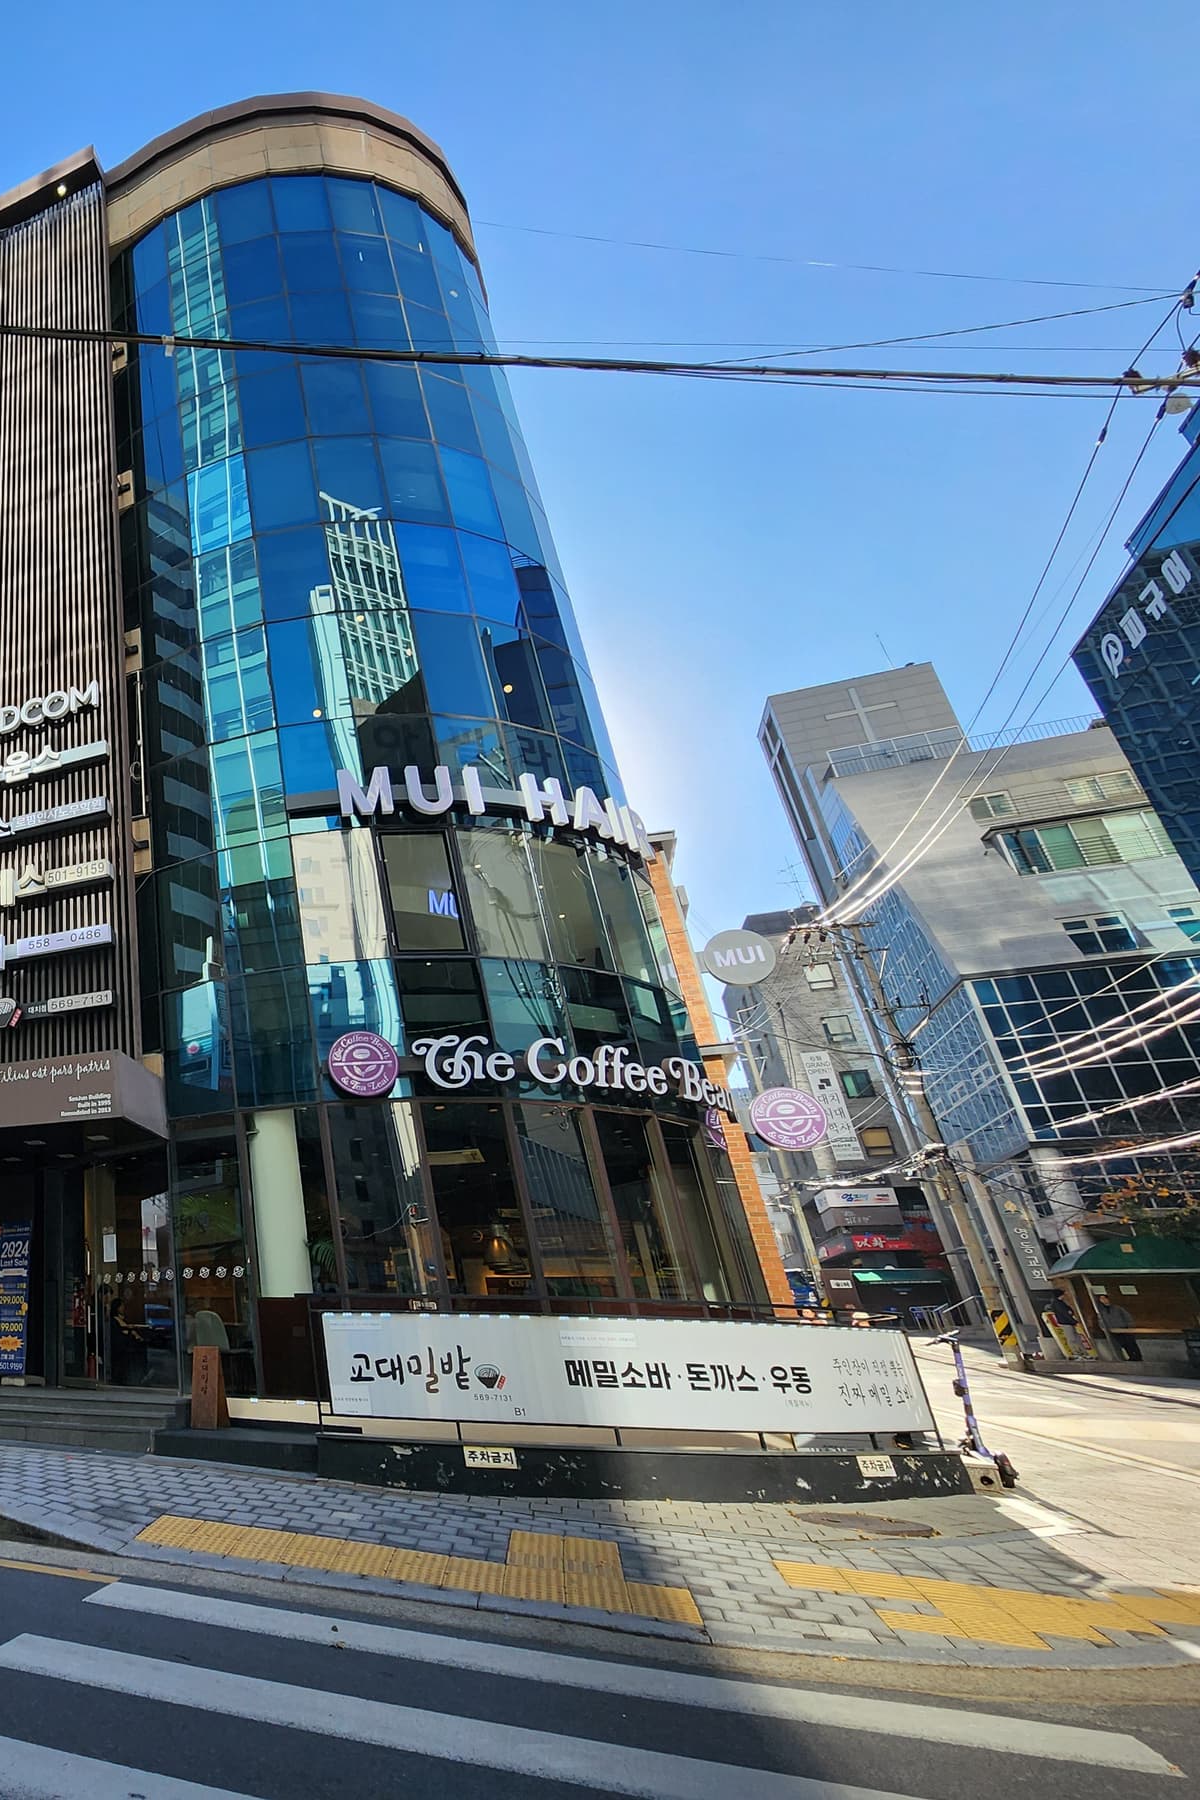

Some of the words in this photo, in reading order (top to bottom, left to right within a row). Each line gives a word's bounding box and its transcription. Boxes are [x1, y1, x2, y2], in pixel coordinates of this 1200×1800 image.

[1119, 550, 1192, 649] 피규어
[337, 765, 485, 817] MUI
[518, 772, 657, 861] HAIR
[48, 862, 105, 883] 501-9159
[712, 942, 766, 970] MUI
[51, 993, 109, 1010] 569-7131
[32, 1065, 48, 1079] est
[49, 1065, 73, 1083] pars
[75, 1060, 110, 1080] patris
[411, 1035, 515, 1090] The
[526, 1038, 668, 1096] Coffee
[668, 1057, 733, 1113] Bean
[1, 1240, 29, 1258] 2024
[0, 1259, 13, 1267] Last
[14, 1258, 28, 1266] Sale
[350, 1345, 471, 1393] 교대밀밭
[769, 1365, 812, 1394] 우동
[833, 1358, 870, 1376] 주인장이
[473, 1394, 512, 1402] 569-7131
[838, 1382, 866, 1406] 진짜
[868, 1383, 893, 1407] 메밀
[514, 1408, 526, 1416] B1
[467, 1449, 514, 1464] 주차금지
[862, 1460, 892, 1472] 주차금지
